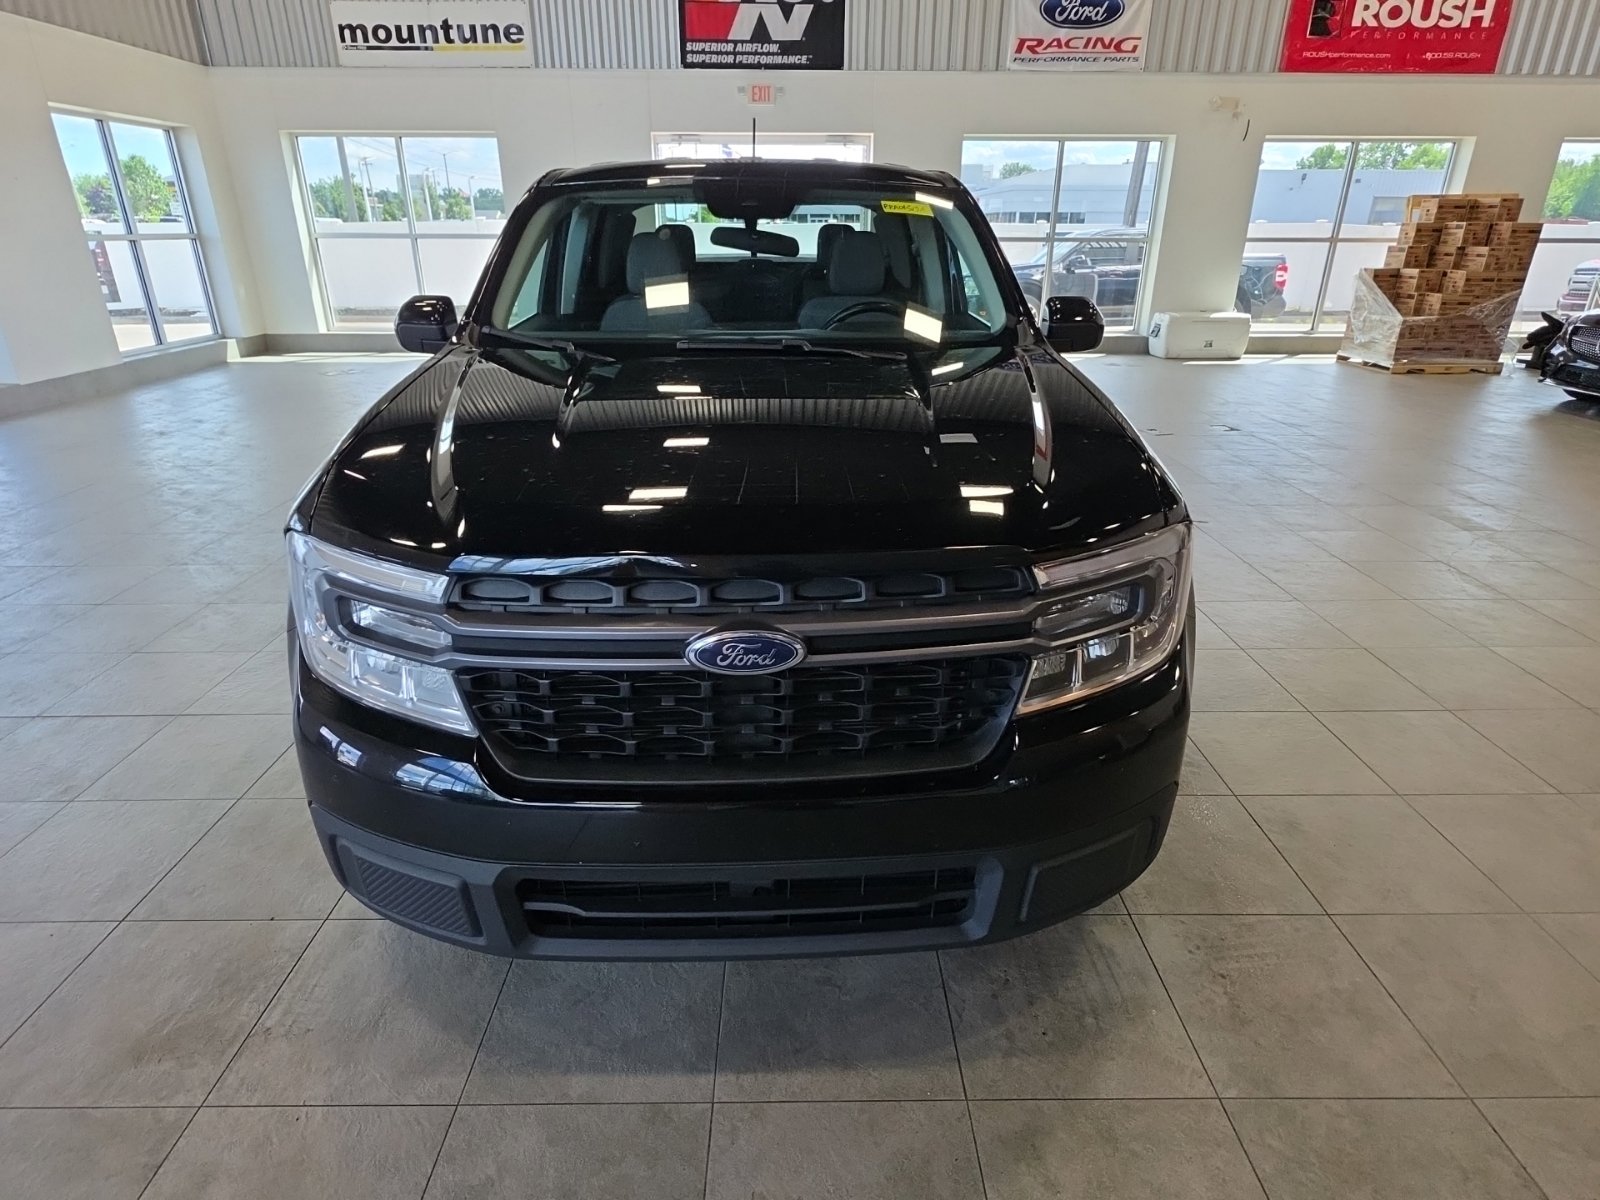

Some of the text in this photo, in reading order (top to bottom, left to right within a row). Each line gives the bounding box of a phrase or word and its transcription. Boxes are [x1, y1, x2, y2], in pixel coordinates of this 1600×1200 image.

[1055, 0, 1109, 21] Ford
[1351, 0, 1495, 28] ROUSH
[338, 18, 525, 44] mountune
[1350, 30, 1488, 40] PERFORMANCE
[686, 42, 781, 53] SUPERIOR AIRFLOW.
[1014, 36, 1142, 54] RACING
[686, 54, 734, 63] SUPERIOR
[751, 85, 772, 102] EXIT
[716, 643, 777, 666] Ford
